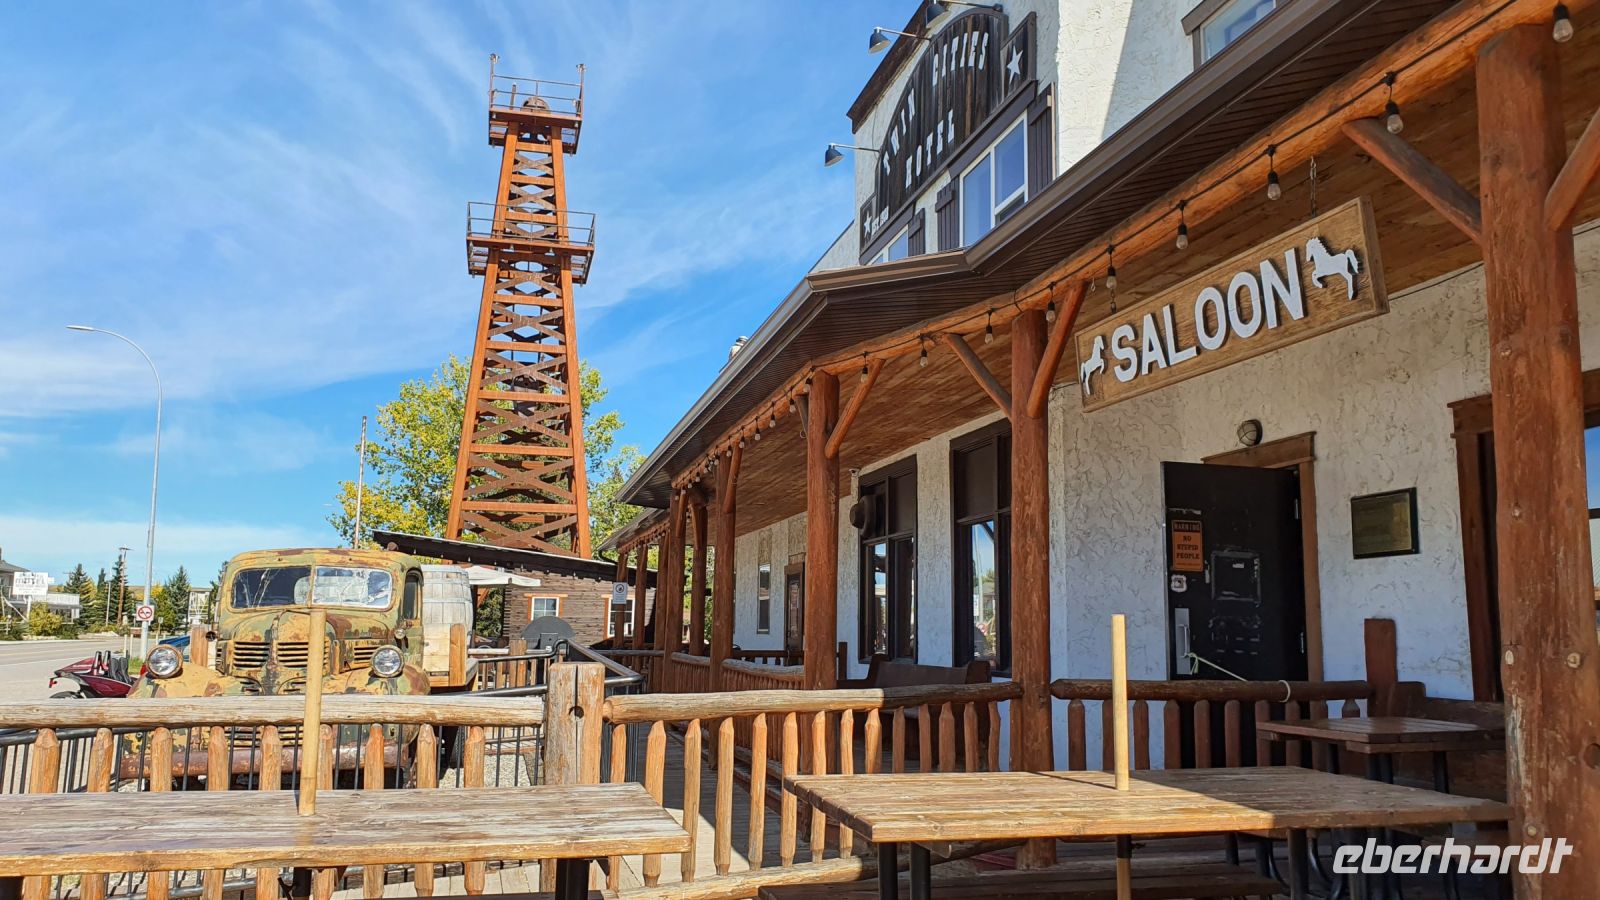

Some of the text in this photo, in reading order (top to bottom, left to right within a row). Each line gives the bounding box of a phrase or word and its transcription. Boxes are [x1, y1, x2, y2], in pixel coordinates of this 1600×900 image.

[883, 31, 989, 176] TWIN CITIES
[906, 109, 955, 189] HOTEL
[1111, 247, 1305, 383] SALOON
[1174, 522, 1200, 531] WARNING
[1176, 552, 1200, 560] PEOPLE
